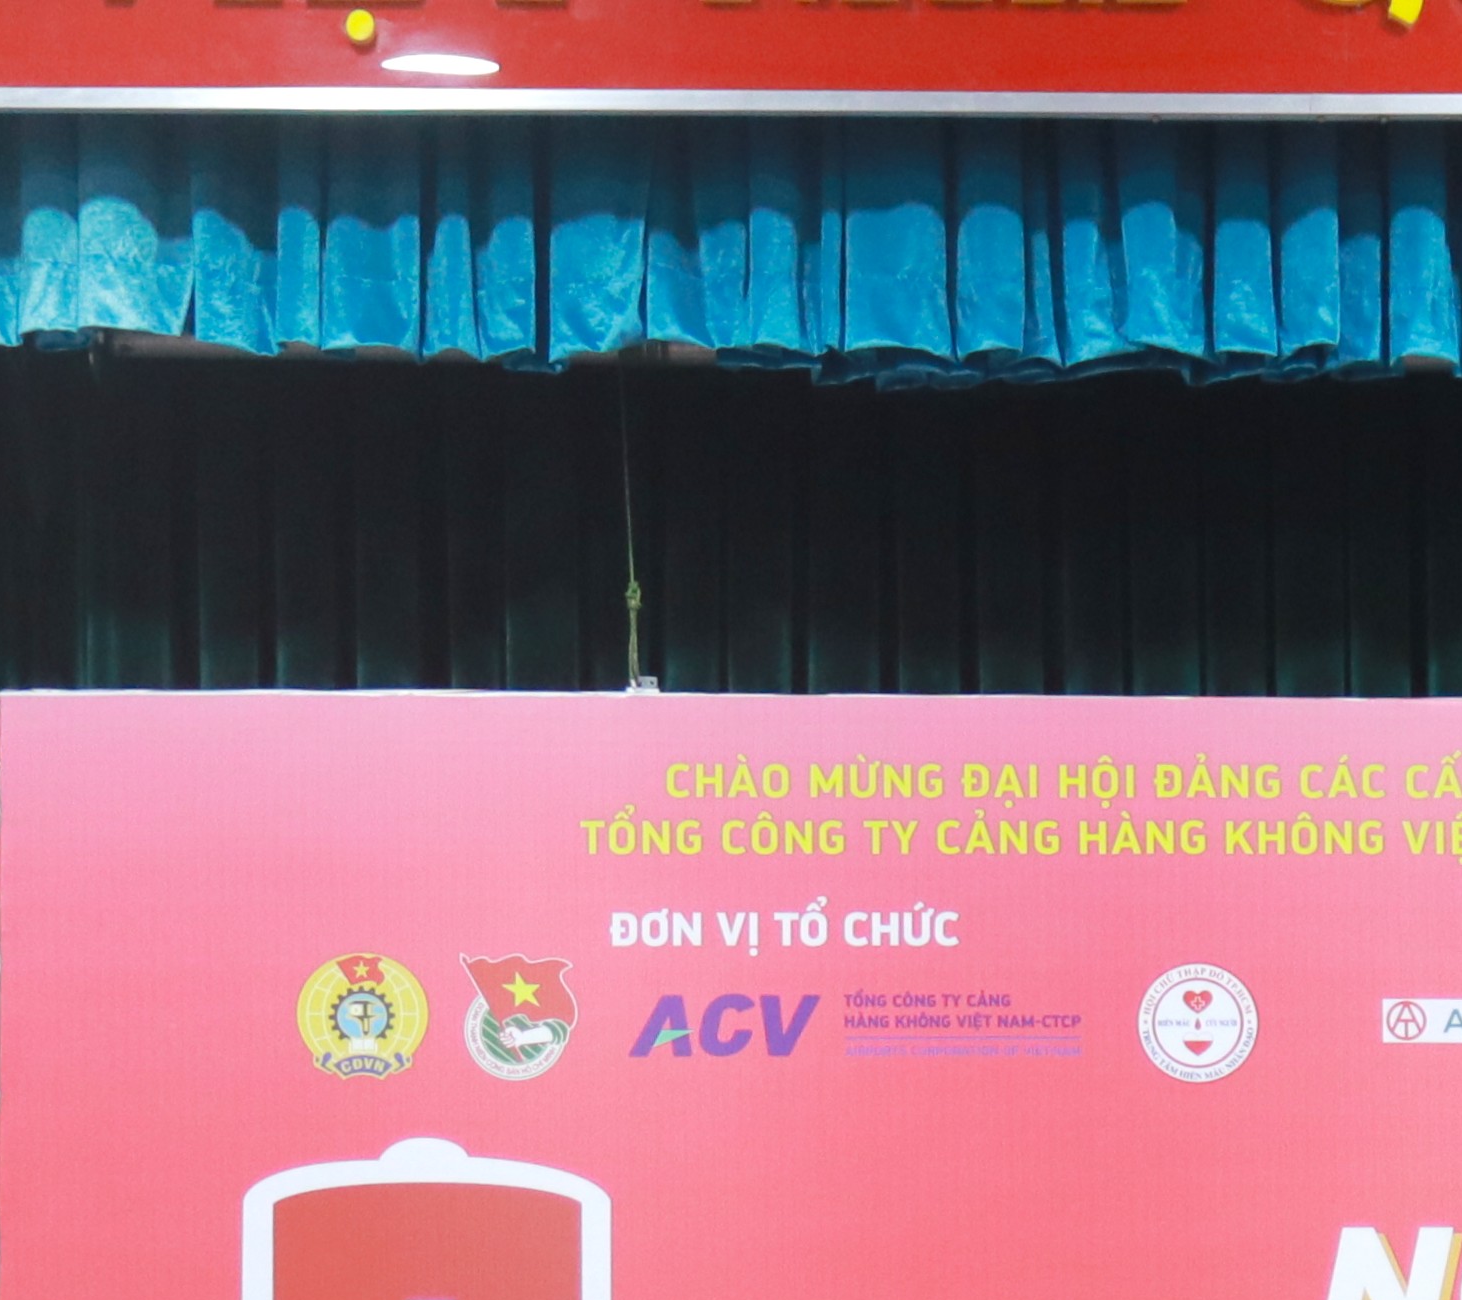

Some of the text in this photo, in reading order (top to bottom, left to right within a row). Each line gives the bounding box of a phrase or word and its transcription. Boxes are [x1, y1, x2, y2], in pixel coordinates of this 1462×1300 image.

[666, 755, 790, 798] CHÀO
[810, 755, 944, 799] MỪNG
[962, 763, 1038, 809] ĐẠI
[1059, 756, 1136, 809] HỘI
[1154, 754, 1282, 798] ĐẢNG
[1300, 756, 1385, 799] CÁC
[580, 805, 703, 855] TỔNG
[722, 812, 846, 855] CÔNG
[864, 820, 918, 854] TY
[936, 810, 1061, 855] CẢNG
[1079, 812, 1207, 855] HÀNG
[1225, 812, 1385, 855] KHÔNG
[610, 896, 958, 956] ĐƠN VỊ TỔ CHỨC
[891, 991, 936, 1008] CÔNG
[941, 993, 962, 1007] TY
[894, 1012, 951, 1028] KHÔNG
[997, 1013, 1082, 1029] NAM-CTCP
[628, 993, 822, 1059] ACV
